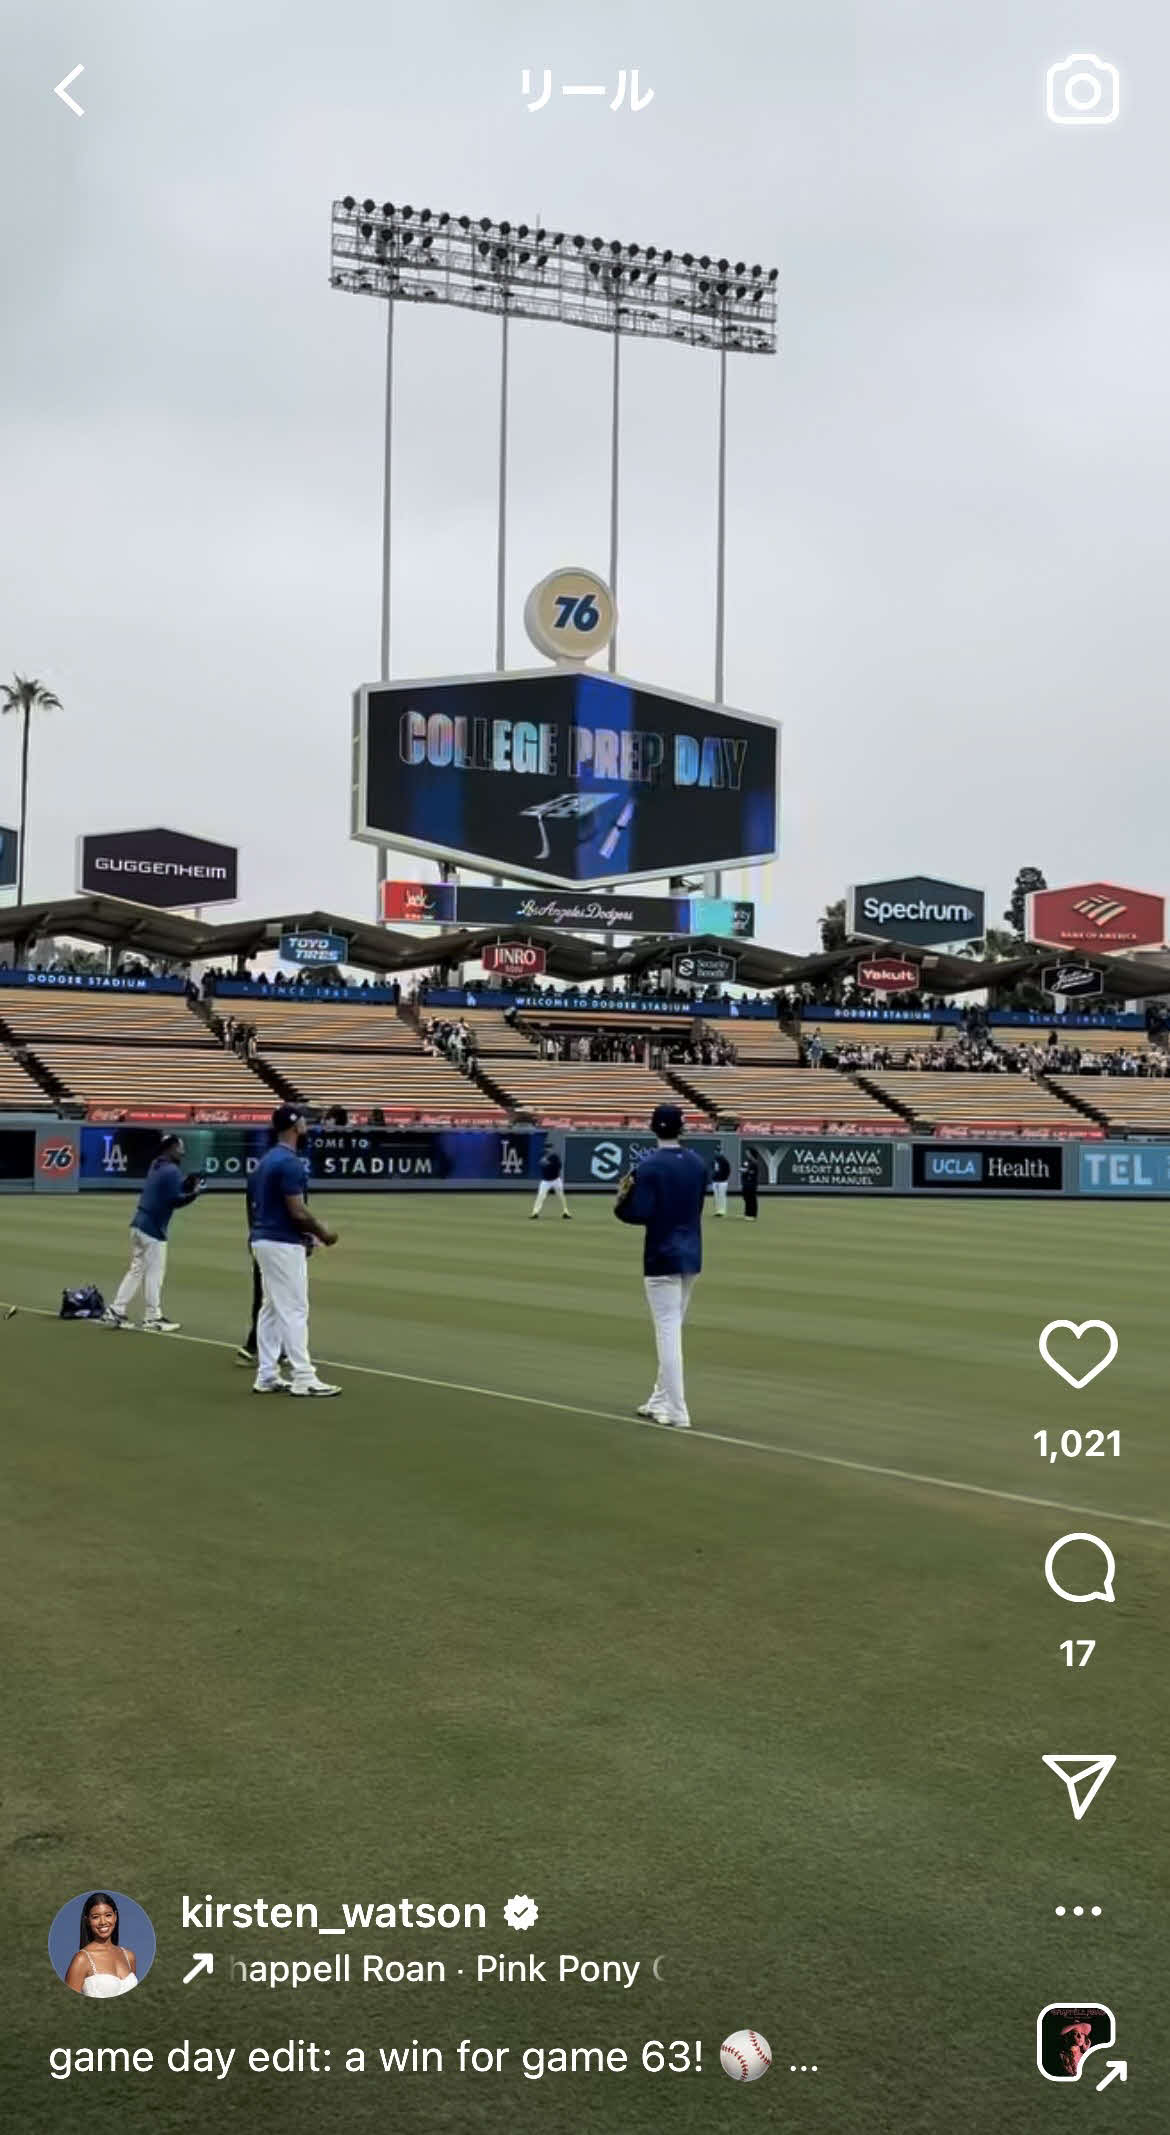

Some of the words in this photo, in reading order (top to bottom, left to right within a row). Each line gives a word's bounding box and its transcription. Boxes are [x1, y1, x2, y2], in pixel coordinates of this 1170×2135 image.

[553, 594, 600, 632] 76
[400, 710, 559, 777] COLLEGE
[568, 725, 665, 784] PREP
[674, 734, 748, 791] DAY
[94, 857, 228, 880] GUGGENHEIM
[584, 902, 634, 926] Dodgers
[863, 897, 970, 924] Spectrum
[289, 937, 330, 949] TOYO
[295, 949, 340, 961] TIRES
[493, 948, 537, 969] JINRO
[27, 973, 84, 985] DODGER
[88, 976, 148, 988] STADIUM
[862, 968, 915, 983] Yakult
[261, 985, 306, 996] SINCE
[515, 996, 569, 1008] WELCOME
[573, 1000, 588, 1010] TO
[642, 1002, 691, 1013] STADIUM
[102, 1135, 128, 1172] LA
[351, 1138, 370, 1149] TO
[41, 1145, 73, 1169] 76
[324, 1157, 433, 1174] STADIUM
[501, 1139, 524, 1174] LA
[792, 1164, 832, 1175] RESORT
[843, 1165, 883, 1176] CASINO
[931, 1158, 976, 1175] UCLA
[987, 1156, 1051, 1179] Health
[1084, 1153, 1153, 1186] TEL
[808, 1175, 830, 1184] SAN
[831, 1176, 874, 1186] MANUEL
